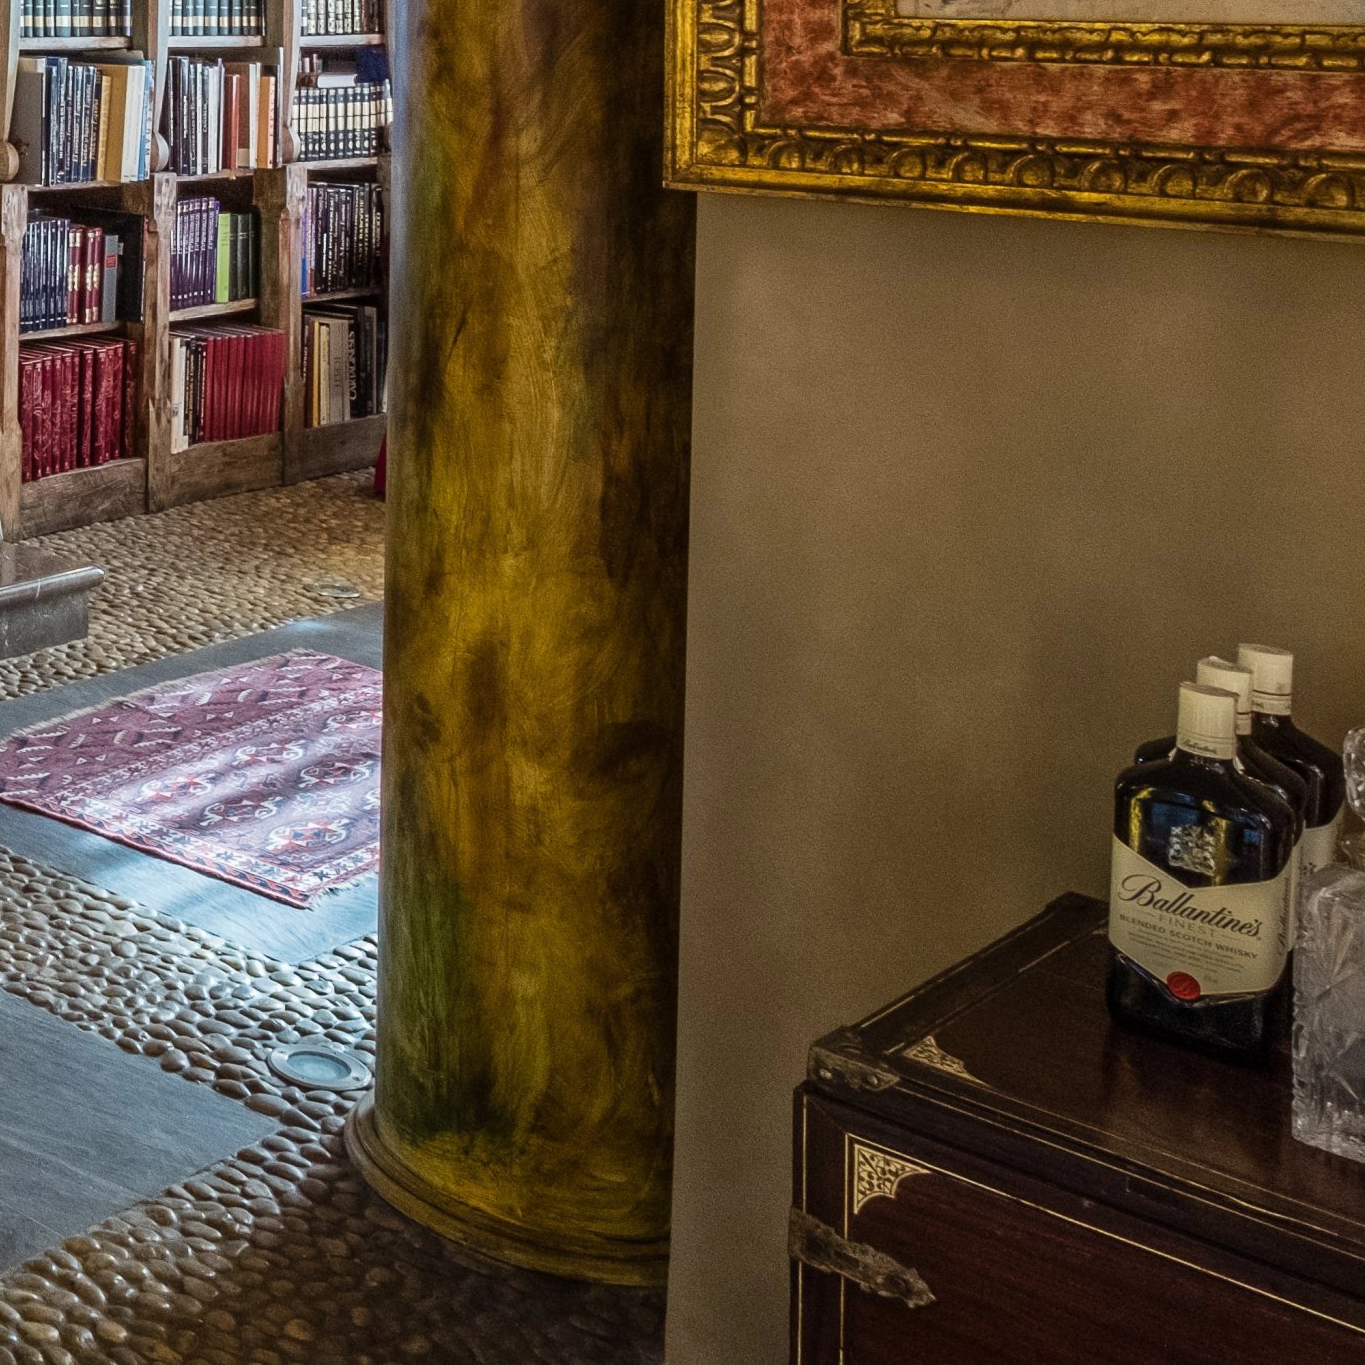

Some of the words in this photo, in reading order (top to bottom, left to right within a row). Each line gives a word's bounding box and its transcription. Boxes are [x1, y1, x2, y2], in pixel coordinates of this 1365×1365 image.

[1118, 874, 1263, 938] Ballantine's
[1158, 914, 1216, 938] FINEST
[1119, 913, 1166, 934] BLENDED
[1169, 929, 1212, 948] SCOTCH
[1215, 943, 1258, 960] WHISKY
